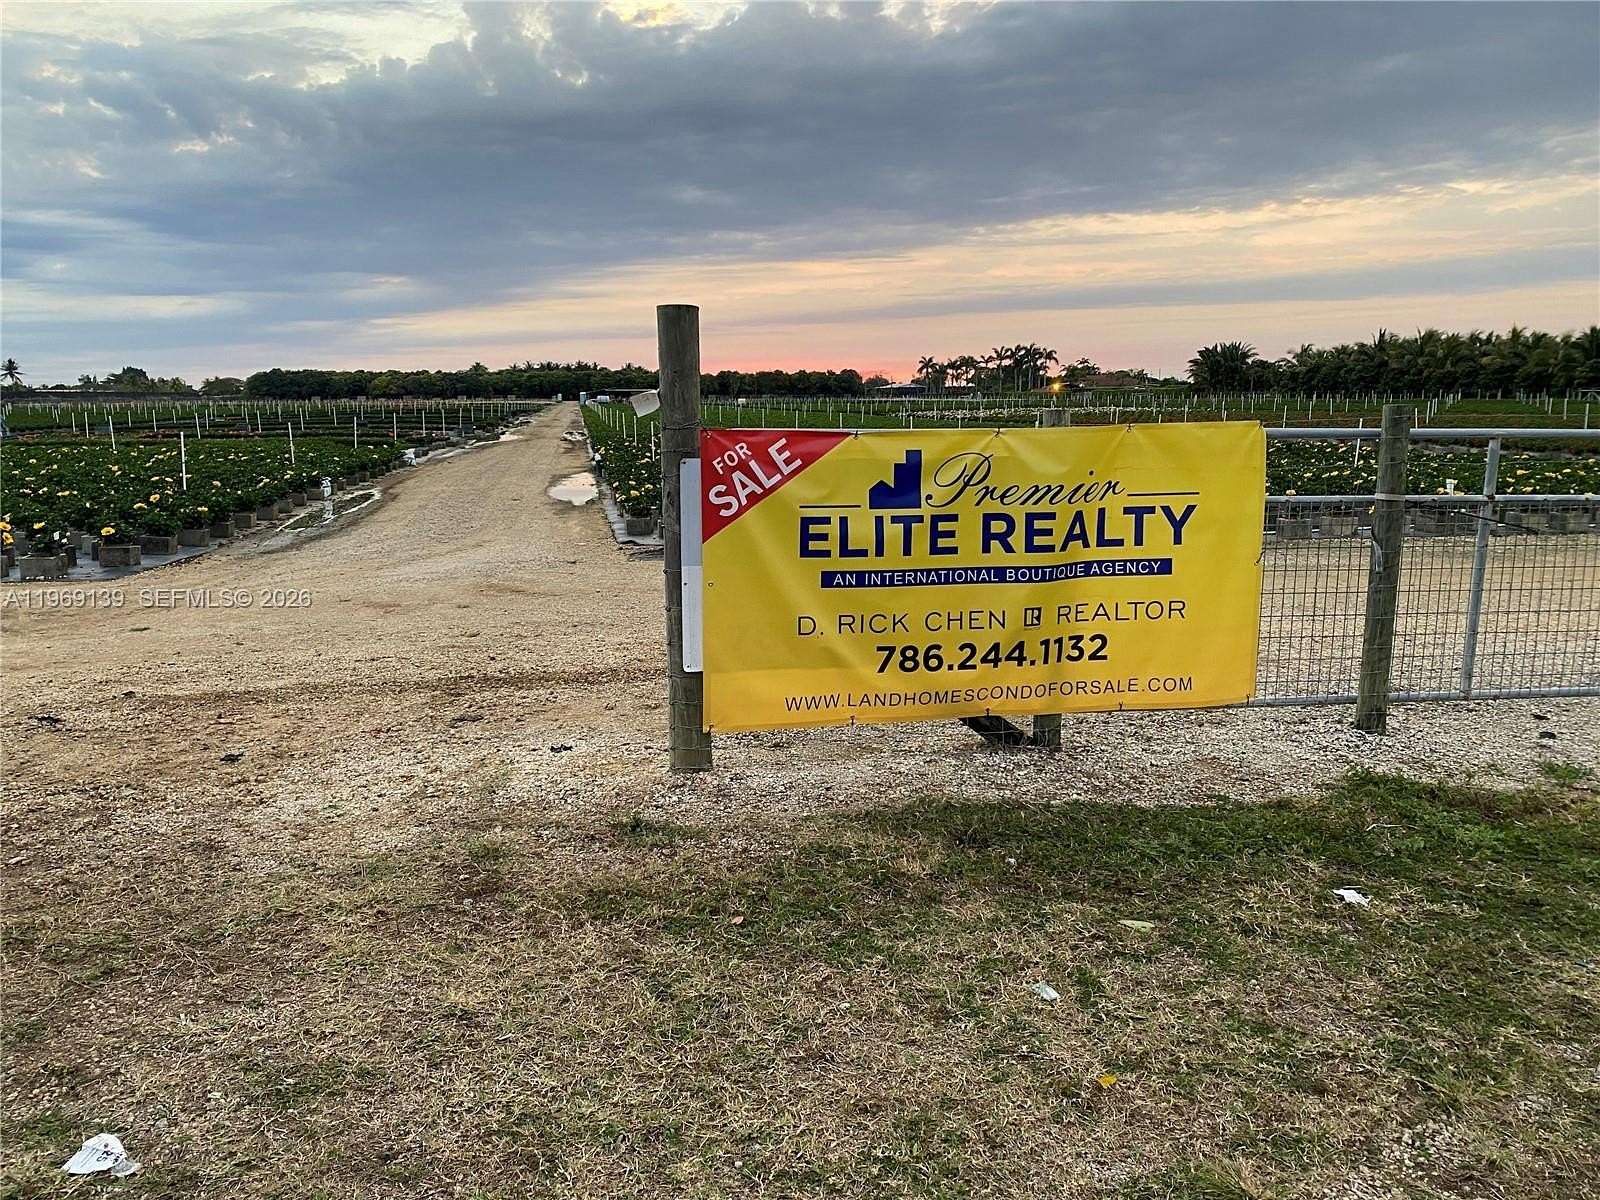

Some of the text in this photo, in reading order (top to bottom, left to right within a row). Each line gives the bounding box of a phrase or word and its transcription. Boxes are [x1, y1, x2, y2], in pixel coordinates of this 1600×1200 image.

[712, 441, 752, 475] FOR
[708, 437, 802, 518] SALE
[925, 452, 1126, 508] Premier
[799, 504, 1197, 558] ELITE REALTY
[832, 561, 1161, 587] AN INTERNATIONAL BOUTIQUE AGENCY
[797, 615, 825, 636] D.
[838, 613, 910, 634] RICK
[925, 610, 1006, 632] CHEN
[1057, 600, 1187, 624] REALTOR
[876, 633, 1109, 674] 786.244.1132
[784, 676, 1193, 712] WWW.LANDHOMESCONDOFORSALE.COM
